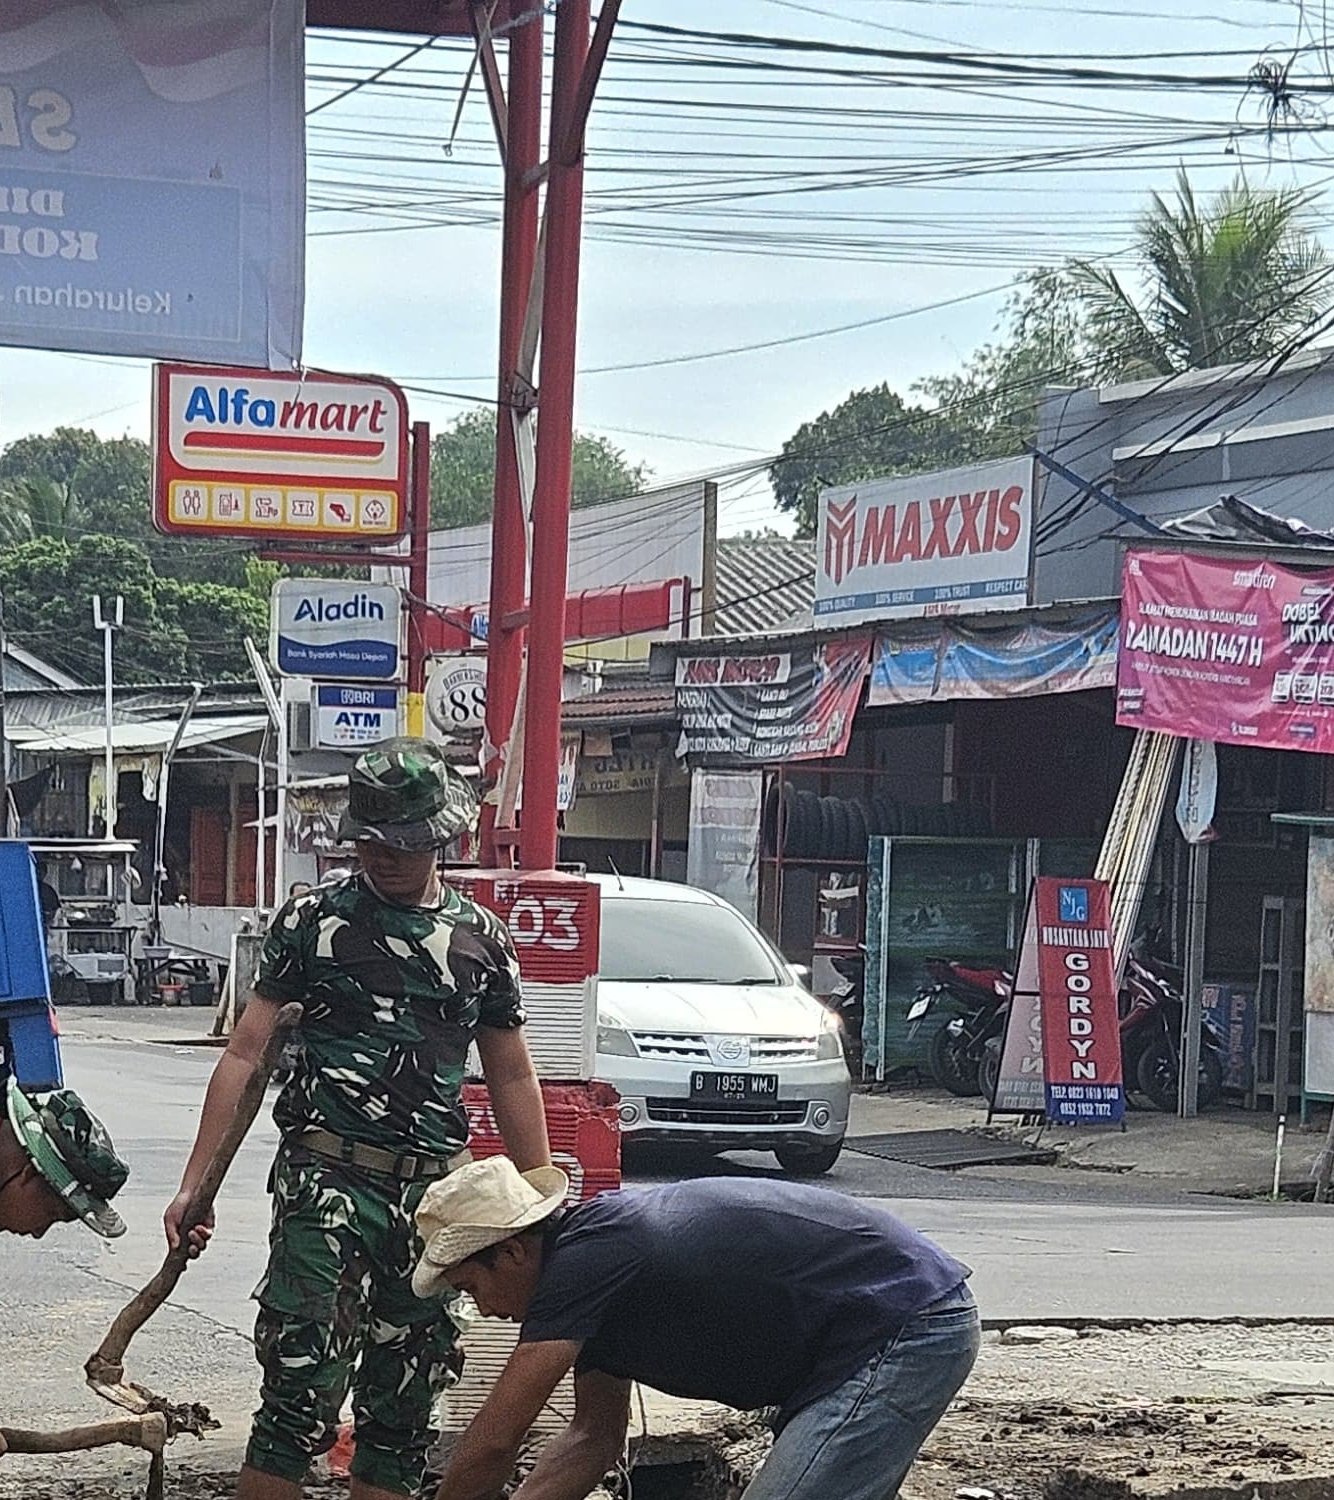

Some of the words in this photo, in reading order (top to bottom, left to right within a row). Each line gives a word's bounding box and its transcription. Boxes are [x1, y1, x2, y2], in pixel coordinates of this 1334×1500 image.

[185, 385, 387, 434] Alfamart
[857, 485, 1024, 568] MAXXIS
[985, 580, 1013, 593] RESPECT
[294, 594, 384, 622] Aladin
[287, 649, 307, 659] Bank
[361, 652, 388, 664] Depan
[1210, 631, 1249, 666] 1447
[1247, 635, 1264, 667] H
[354, 690, 375, 704] BRI
[335, 711, 382, 728] ATM
[508, 897, 581, 951] 03
[1065, 952, 1097, 1080] GORDYN
[695, 1074, 704, 1091] B
[716, 1075, 745, 1092] 1955
[751, 1076, 776, 1093] WMJ
